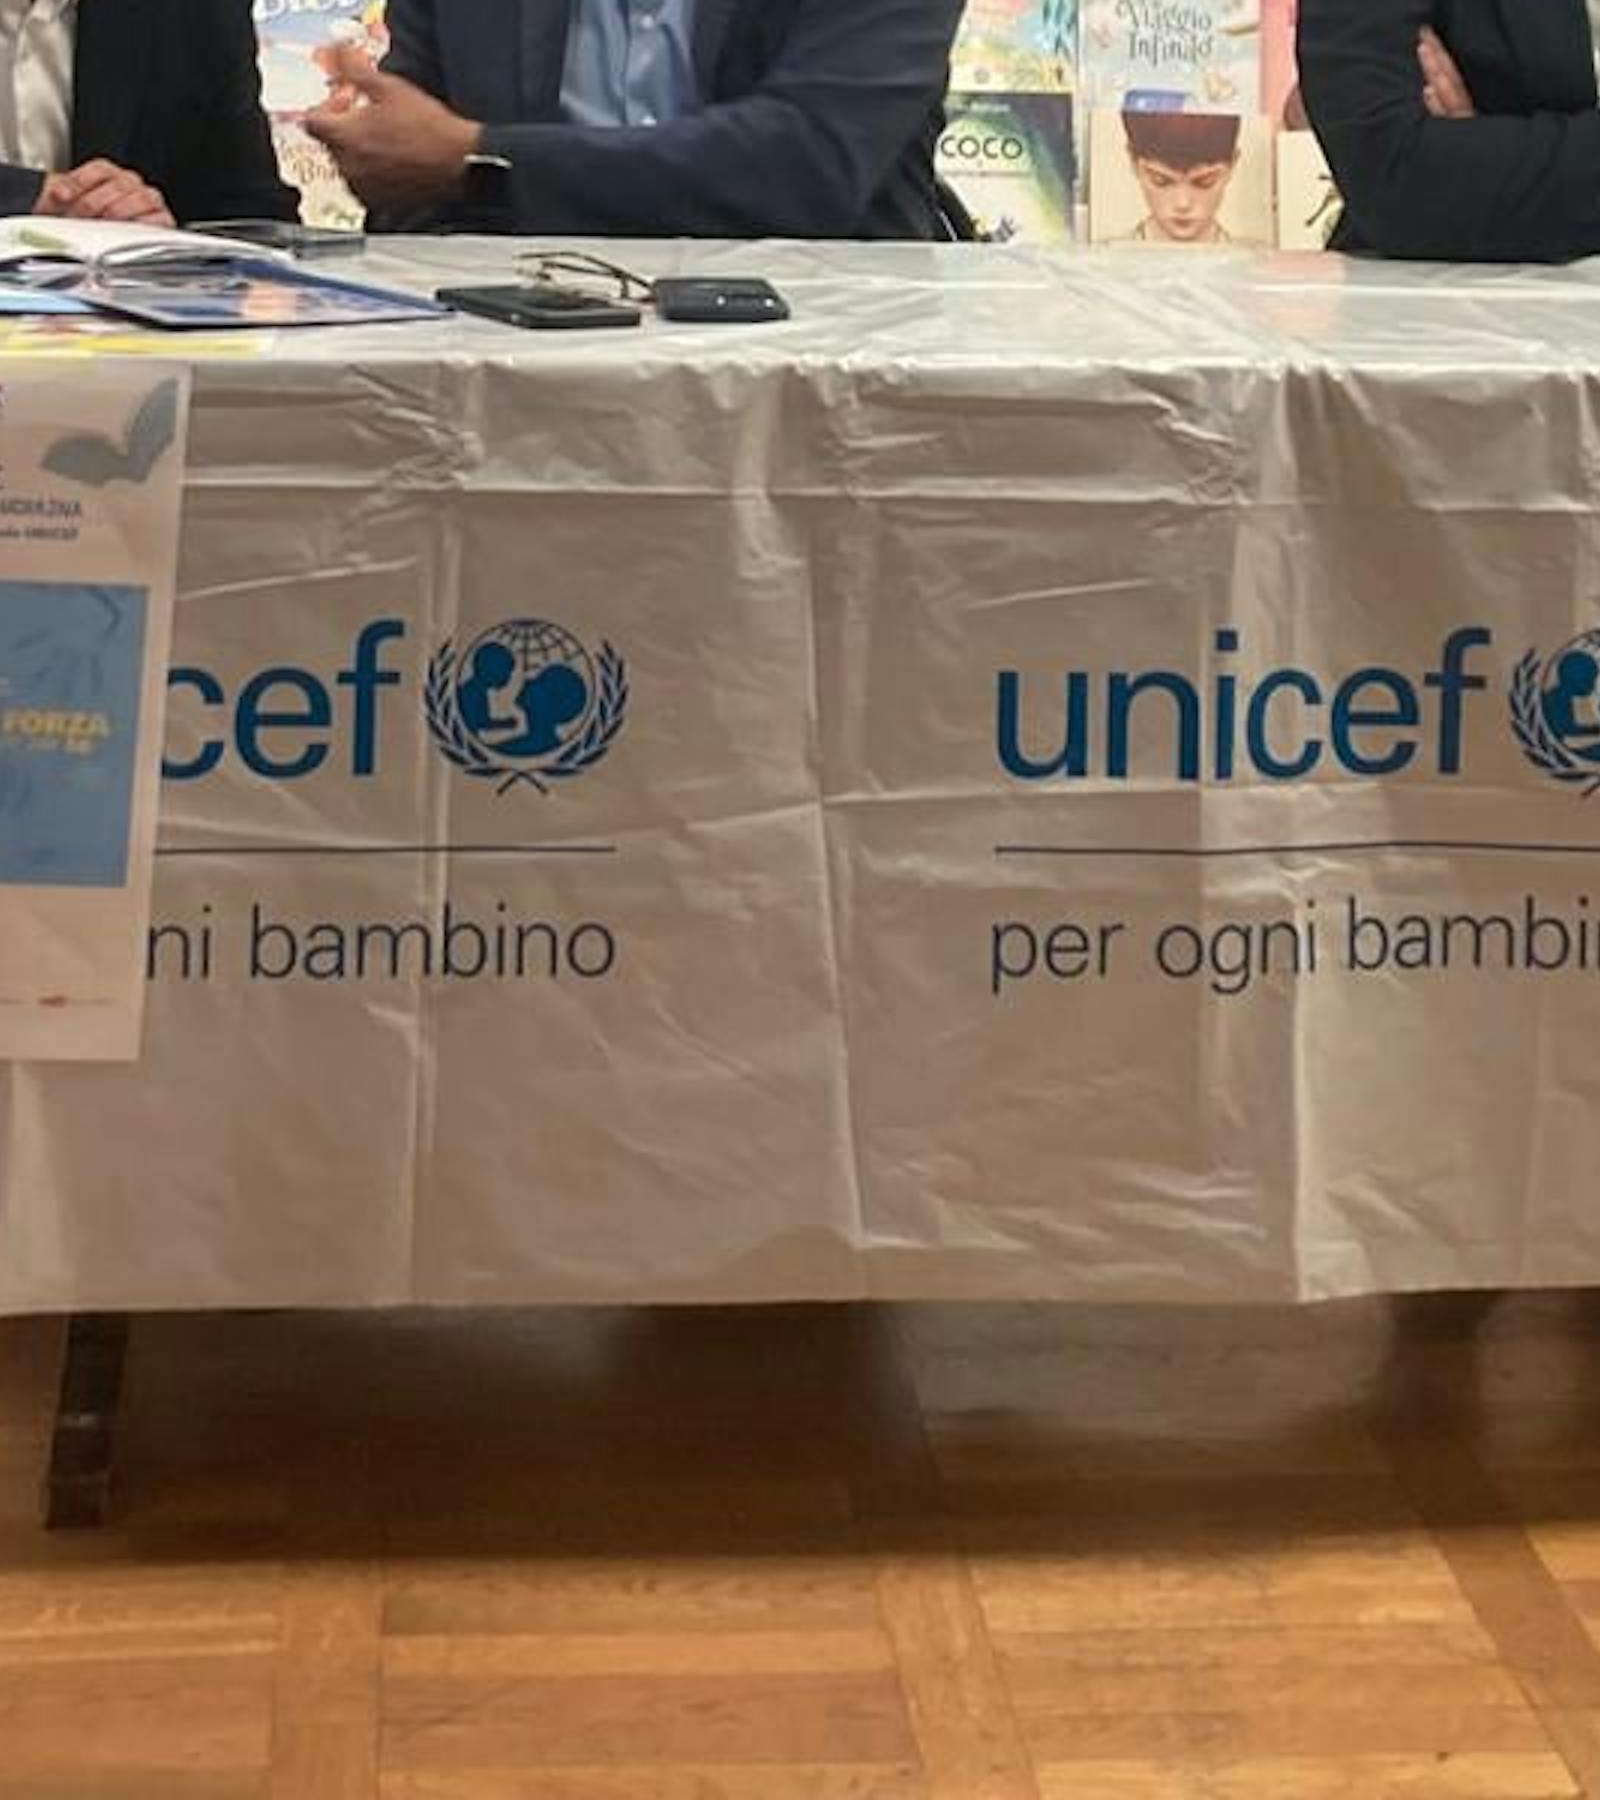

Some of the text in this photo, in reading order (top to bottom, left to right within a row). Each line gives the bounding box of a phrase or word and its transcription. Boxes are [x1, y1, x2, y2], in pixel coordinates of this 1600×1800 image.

[940, 135, 1024, 160] COCO
[161, 619, 406, 779] cef
[997, 626, 1492, 780] unicef
[147, 902, 617, 981] ni bambino
[991, 920, 1125, 996] per
[1155, 898, 1317, 996] ogni
